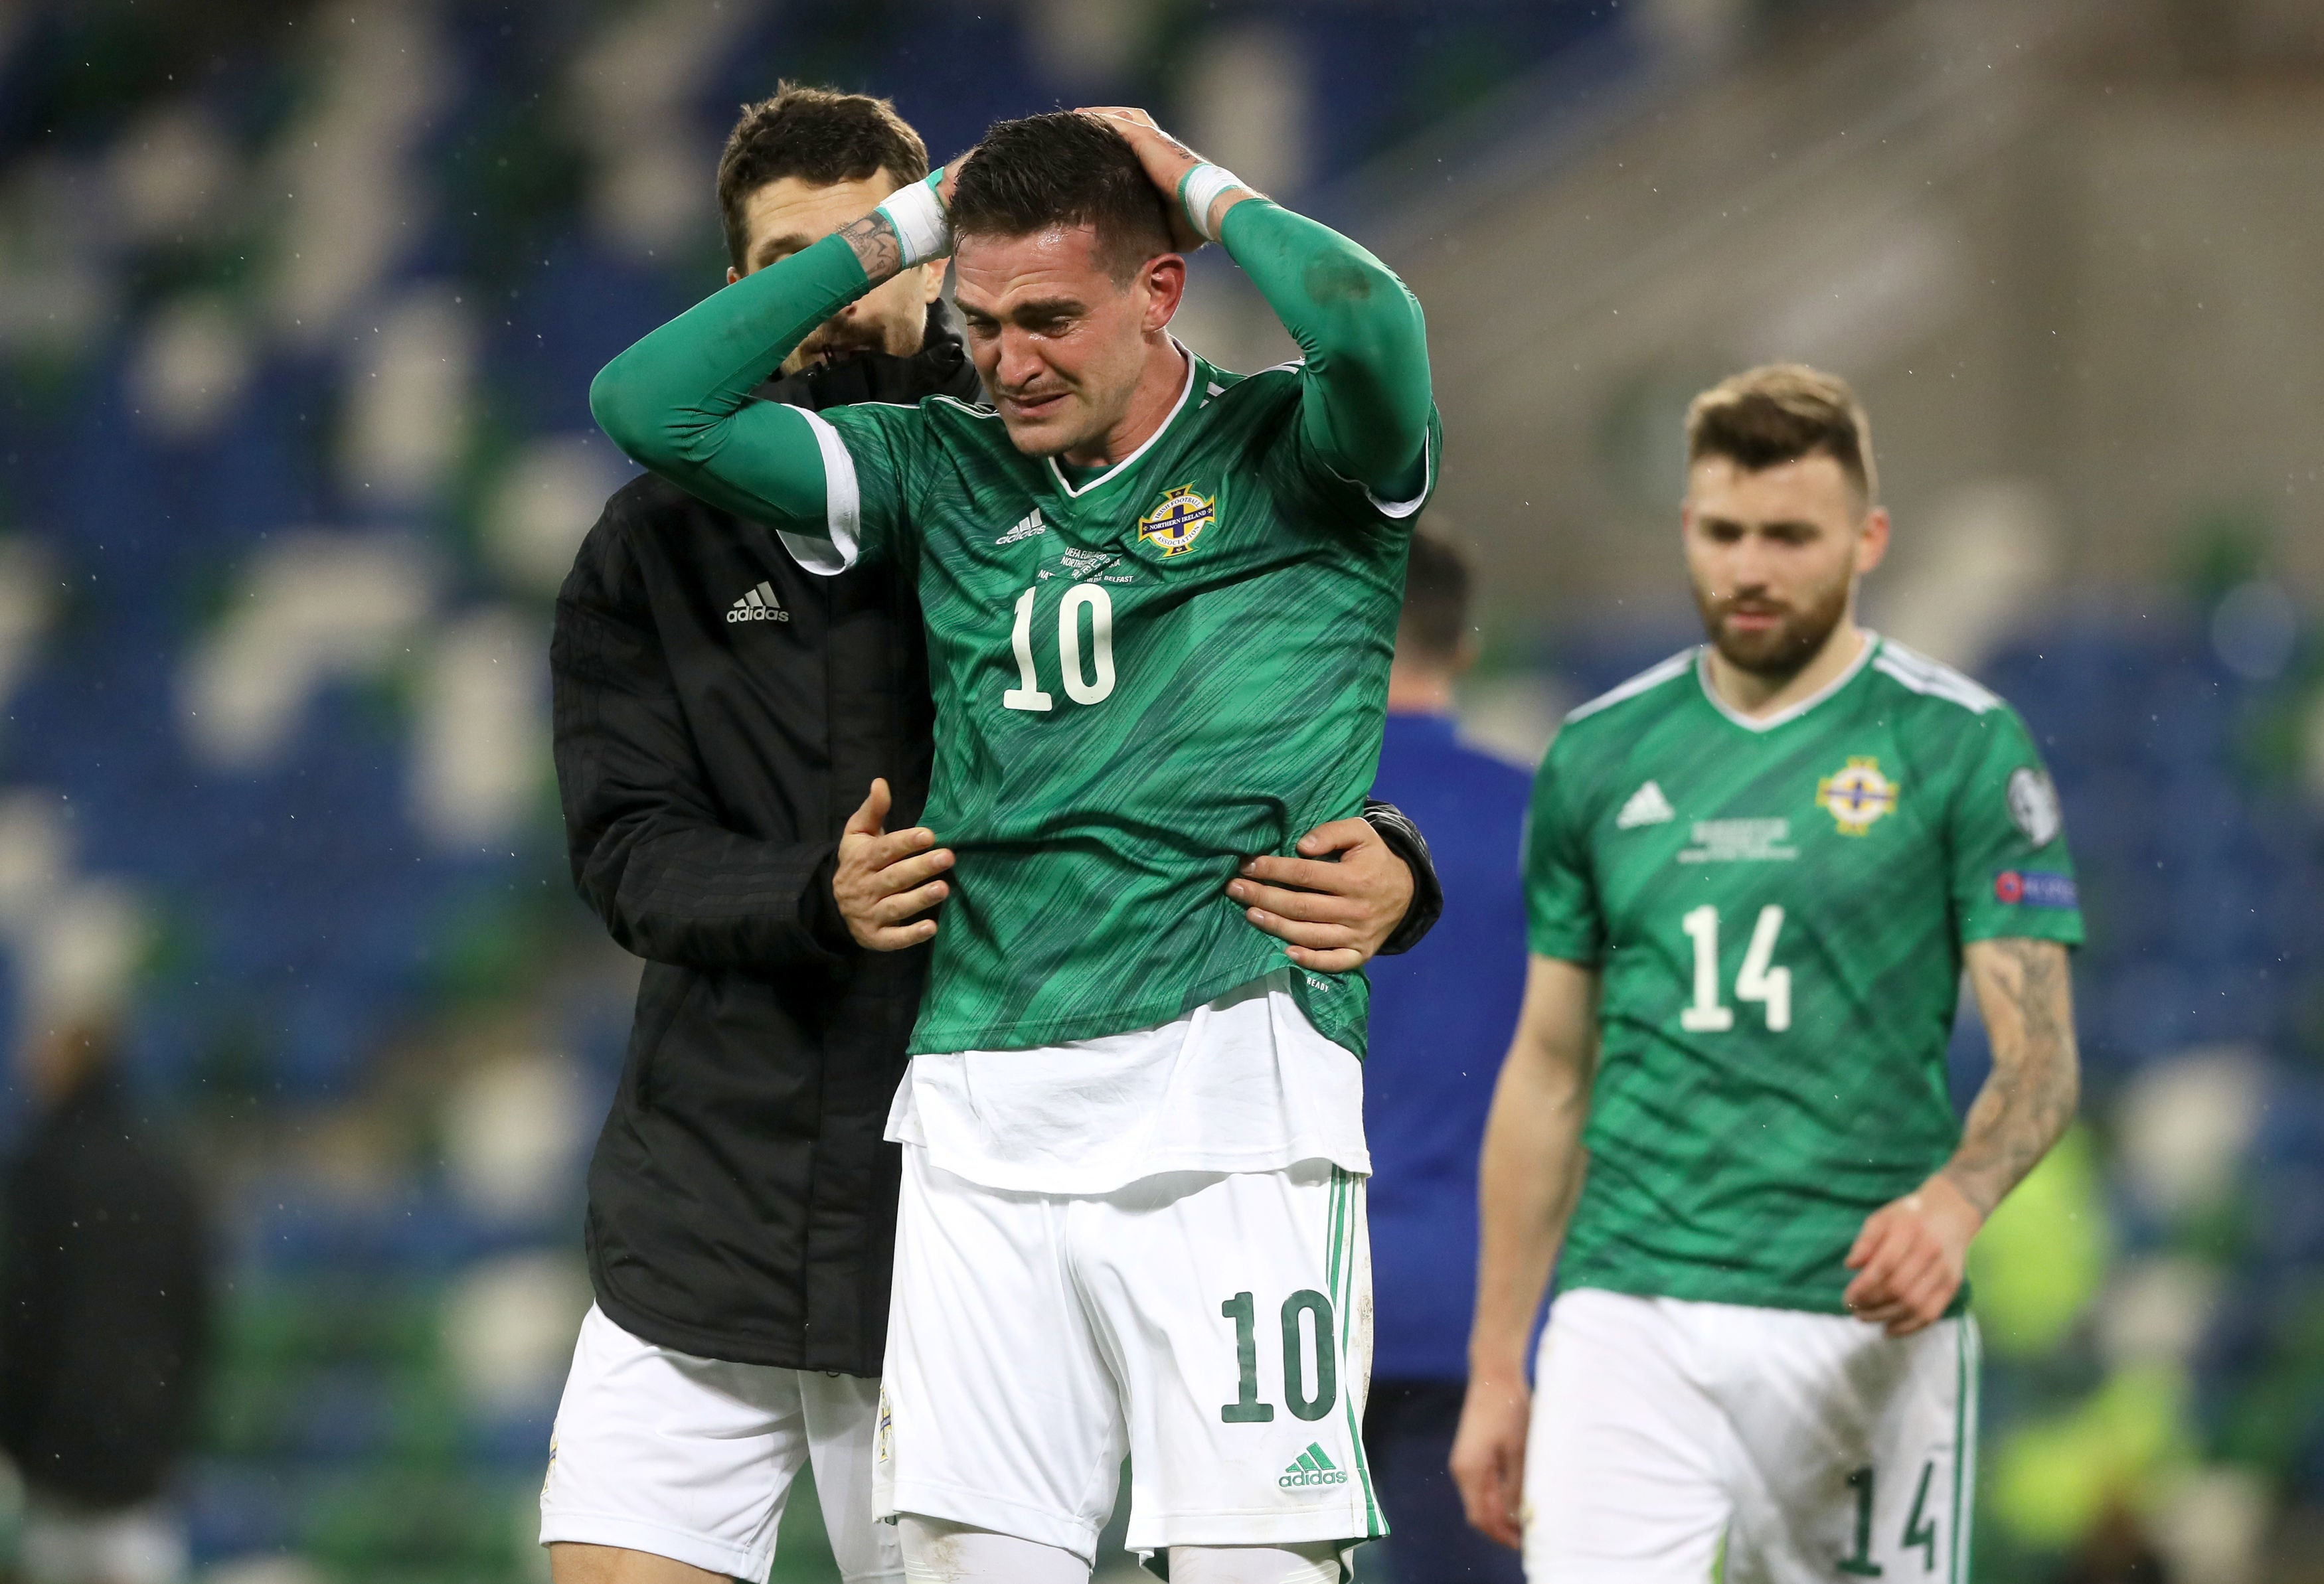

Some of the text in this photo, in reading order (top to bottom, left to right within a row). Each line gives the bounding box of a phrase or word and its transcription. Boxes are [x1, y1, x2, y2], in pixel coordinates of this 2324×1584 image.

[1155, 497, 1201, 519] IRISH FOOTBALL
[1149, 510, 1206, 530] NORTHERN IRELAND
[995, 525, 1046, 544] adidas
[1157, 525, 1200, 545] ASSOCIATION
[1065, 546, 1081, 559] UEFA
[726, 605, 789, 623] adidas
[1003, 583, 1116, 712] 10
[1680, 904, 1792, 1032] 14
[1221, 1289, 1337, 1423] 10
[1278, 1469, 1348, 1488] adidas
[1835, 1459, 1936, 1577] 14
